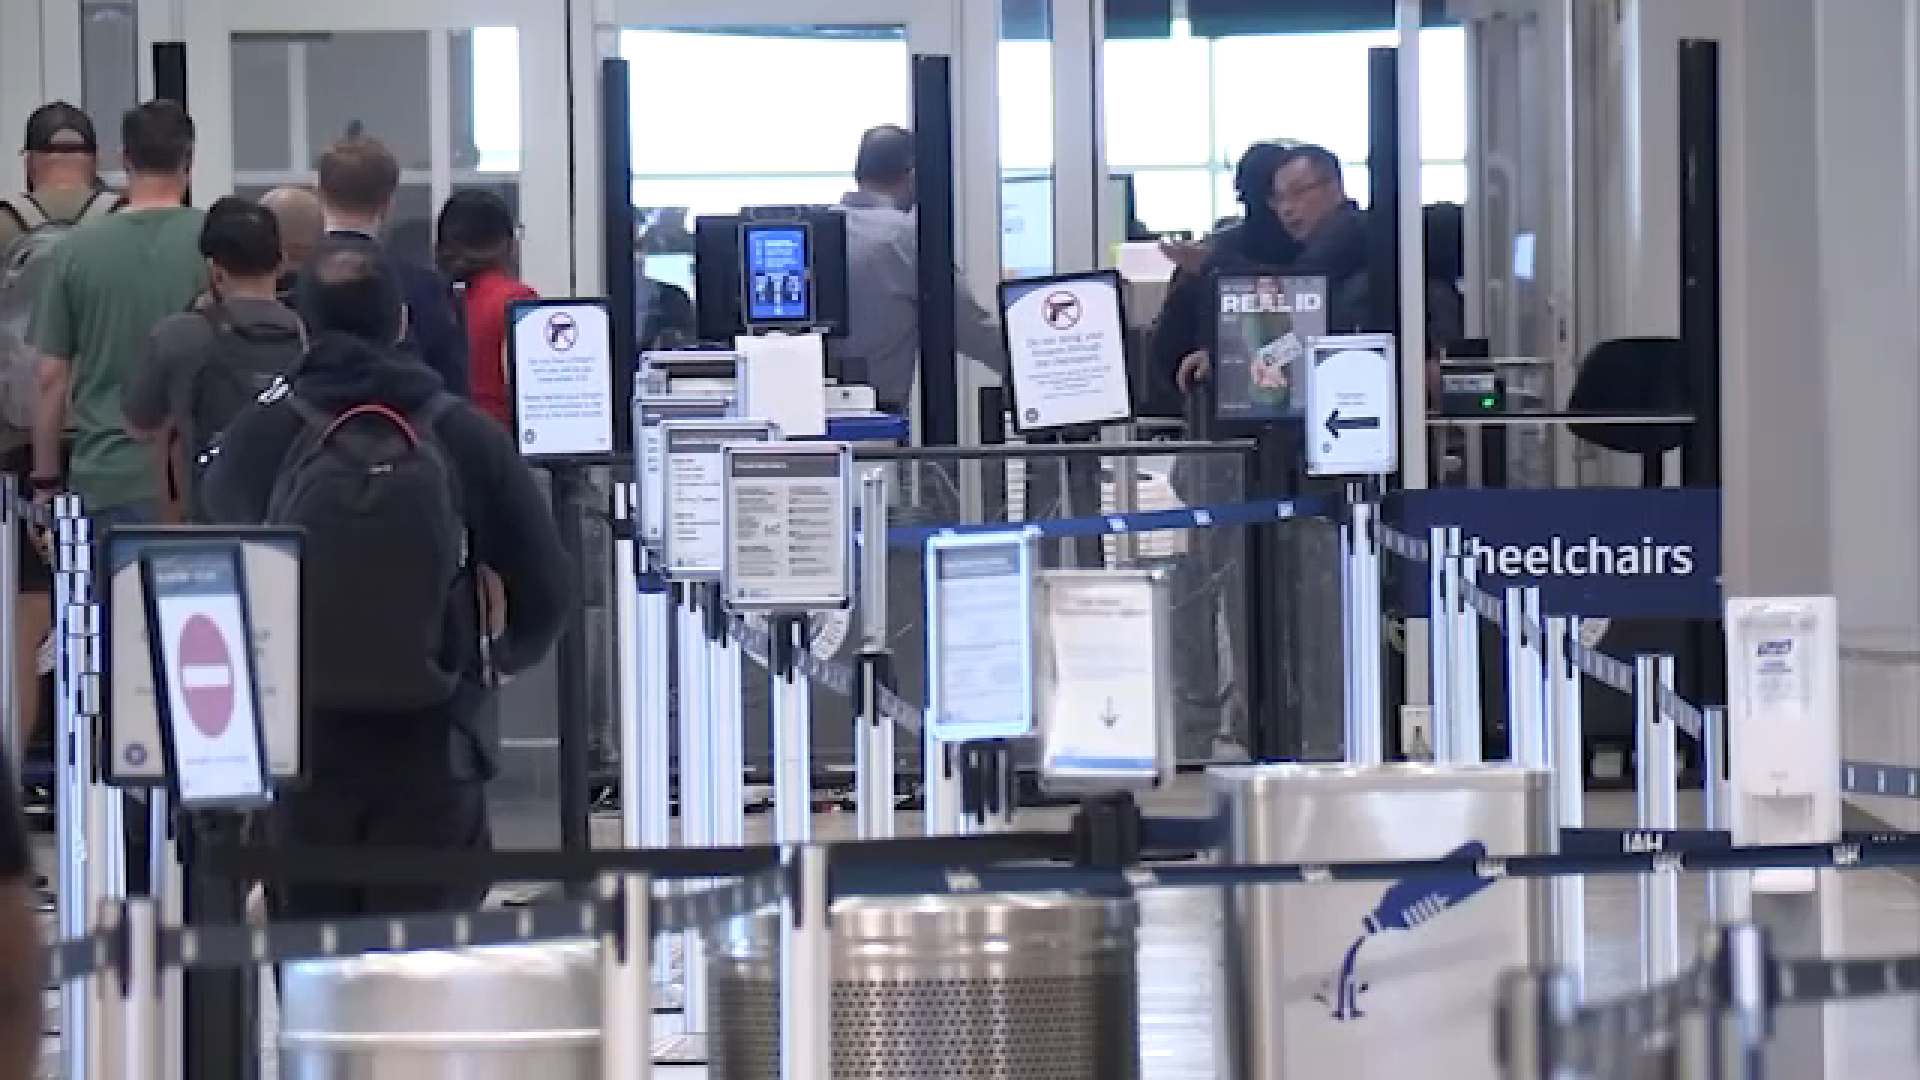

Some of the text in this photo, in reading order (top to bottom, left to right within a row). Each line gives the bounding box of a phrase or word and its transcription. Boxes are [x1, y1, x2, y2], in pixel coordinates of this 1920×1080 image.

[1221, 294, 1321, 312] REAL ID
[1464, 536, 1694, 575] heelchairs
[1623, 833, 1662, 852] IAH
